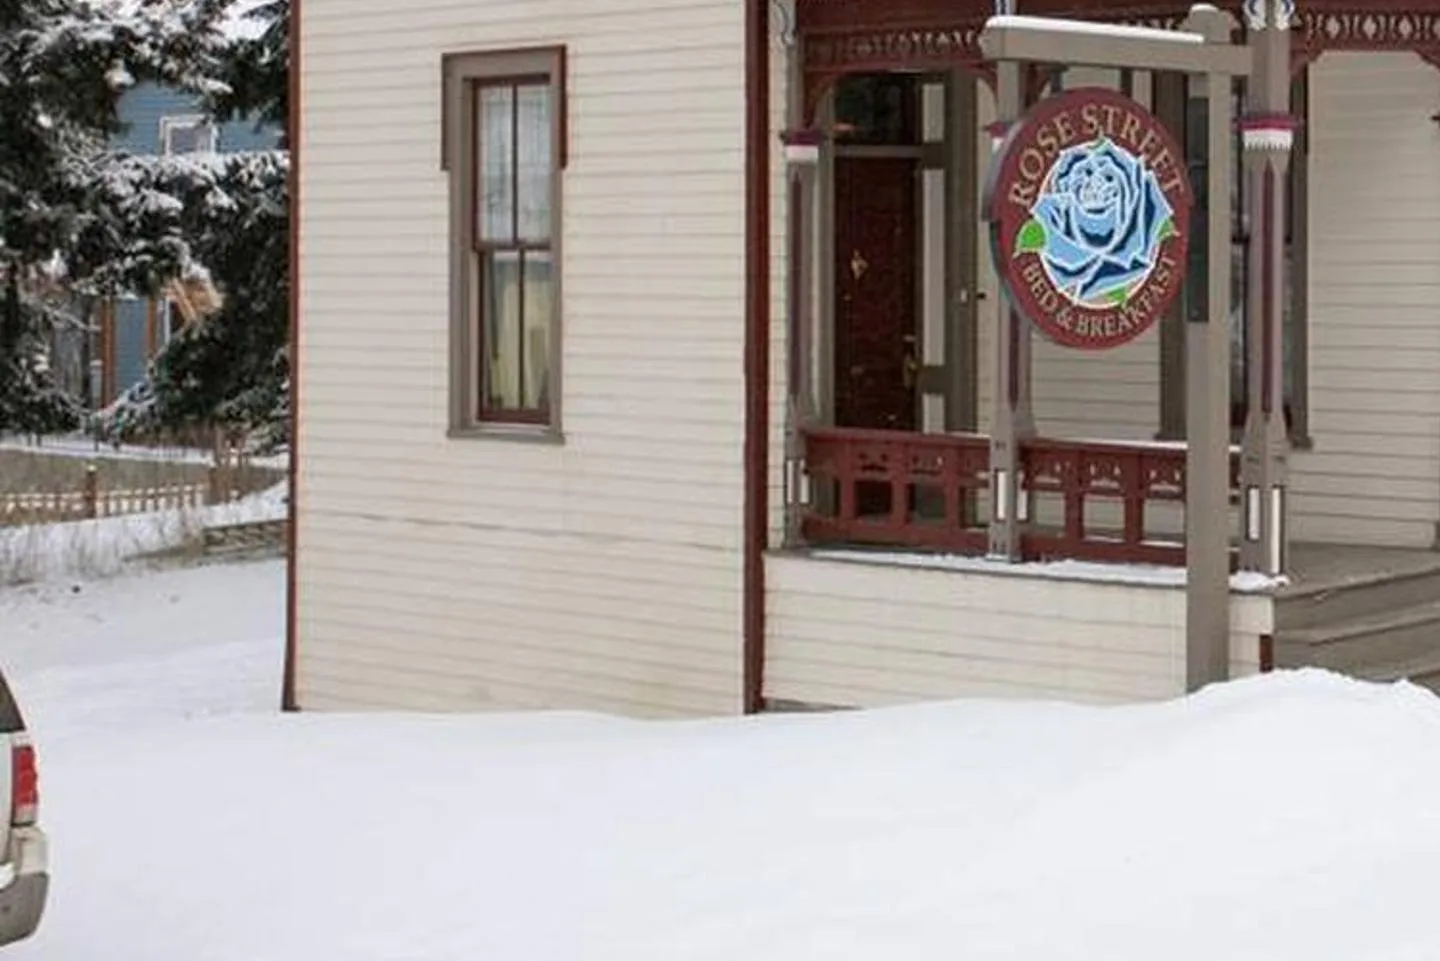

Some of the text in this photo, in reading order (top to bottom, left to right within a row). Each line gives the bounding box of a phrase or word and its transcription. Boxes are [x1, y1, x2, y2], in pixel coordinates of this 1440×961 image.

[1010, 104, 1183, 207] ROSE STREET
[1022, 257, 1176, 336] BED & BREAKFAST
